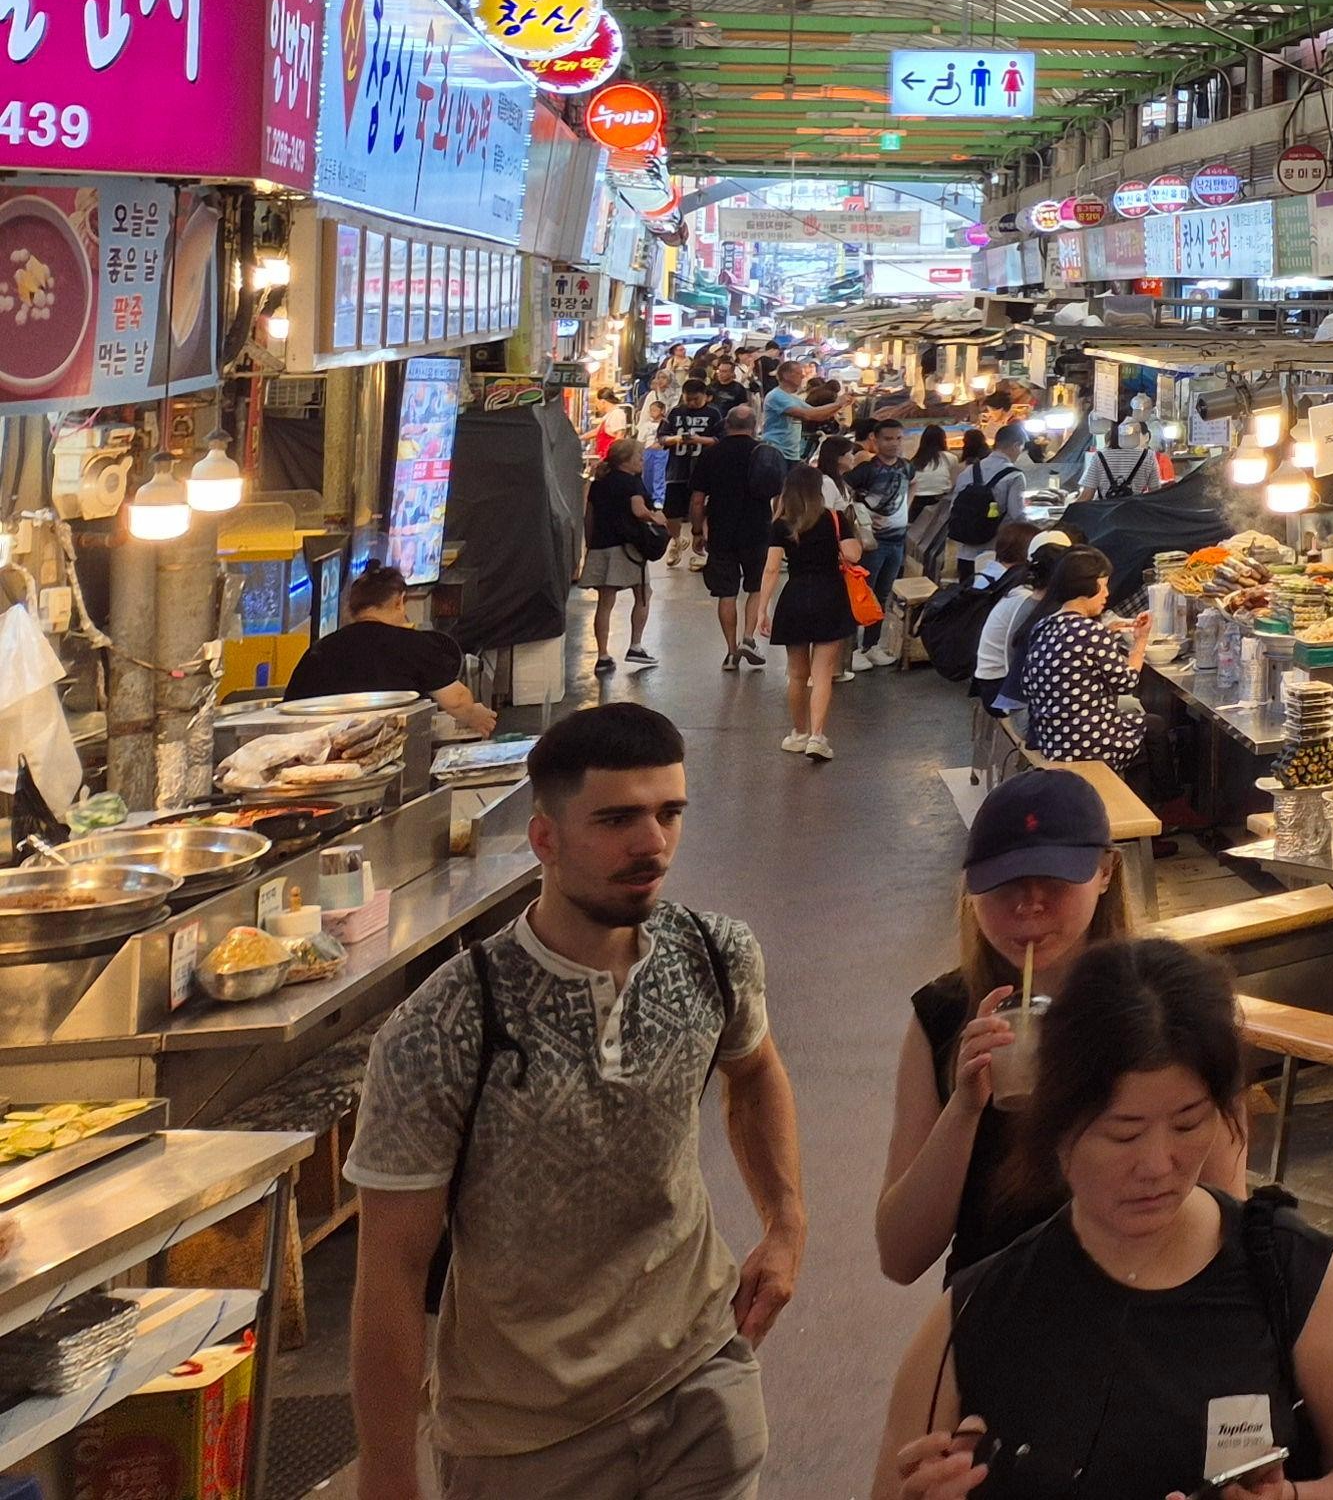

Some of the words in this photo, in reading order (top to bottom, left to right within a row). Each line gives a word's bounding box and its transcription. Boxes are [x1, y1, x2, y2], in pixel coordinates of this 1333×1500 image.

[1284, 168, 1322, 180] 장미집
[112, 202, 159, 238] 오늘은
[107, 247, 137, 284] 좋은
[144, 249, 158, 283] 날
[113, 293, 144, 332] 팥죽
[551, 298, 593, 311] 화장실
[553, 311, 586, 319] TOILET
[98, 341, 128, 377] 먹는
[133, 340, 148, 374] 날
